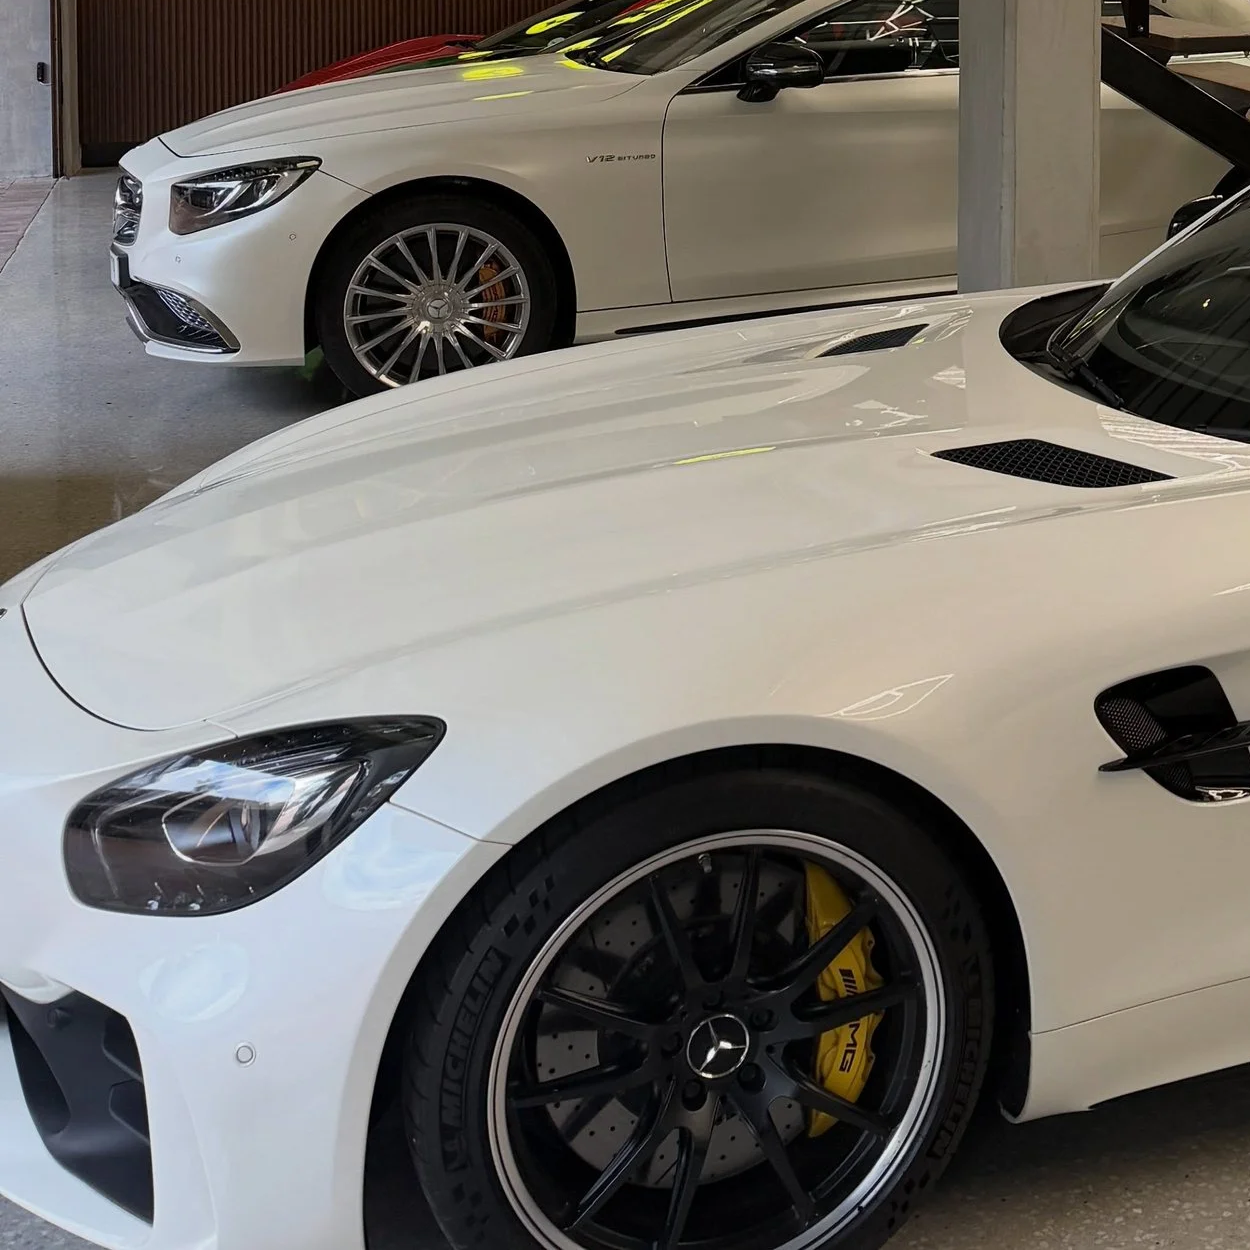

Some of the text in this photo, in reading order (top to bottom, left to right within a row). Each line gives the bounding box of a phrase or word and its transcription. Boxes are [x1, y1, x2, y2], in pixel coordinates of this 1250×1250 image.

[586, 153, 656, 163] V12 BITURBO
[440, 946, 509, 1129] MICHELIN
